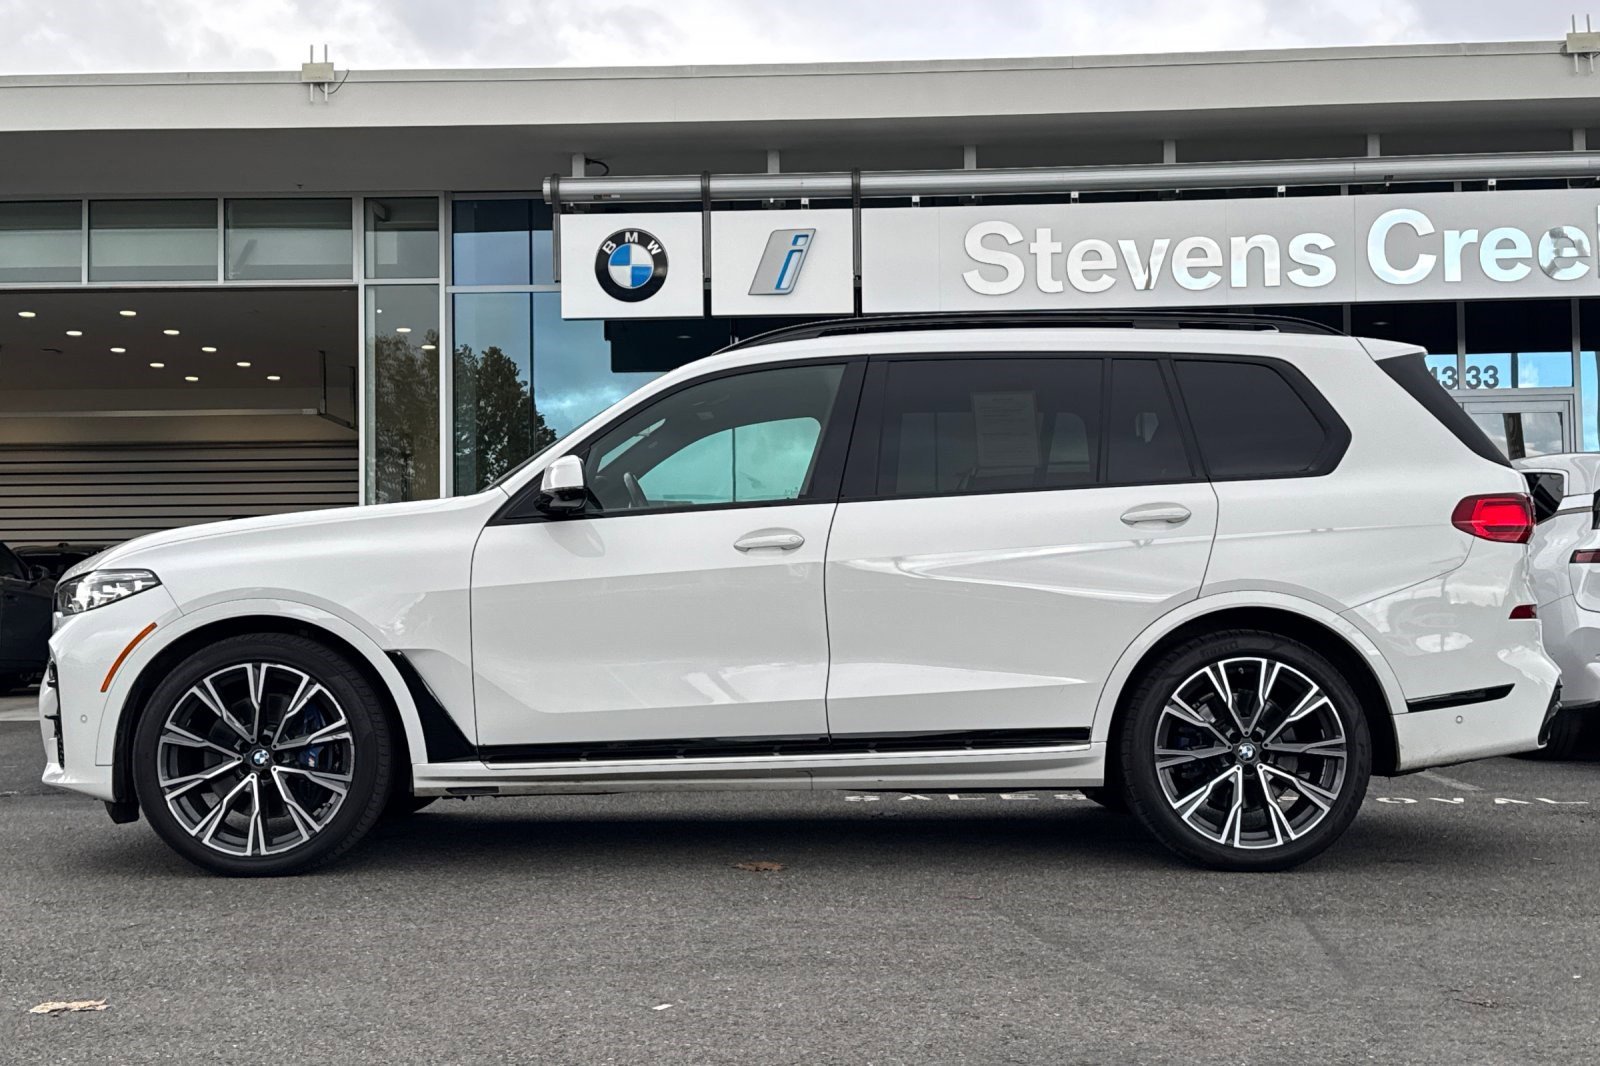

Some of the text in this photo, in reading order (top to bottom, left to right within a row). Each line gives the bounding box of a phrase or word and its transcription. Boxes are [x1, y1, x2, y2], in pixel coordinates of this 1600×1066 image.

[602, 231, 662, 255] BMW
[962, 207, 1600, 295] Stevens Cree
